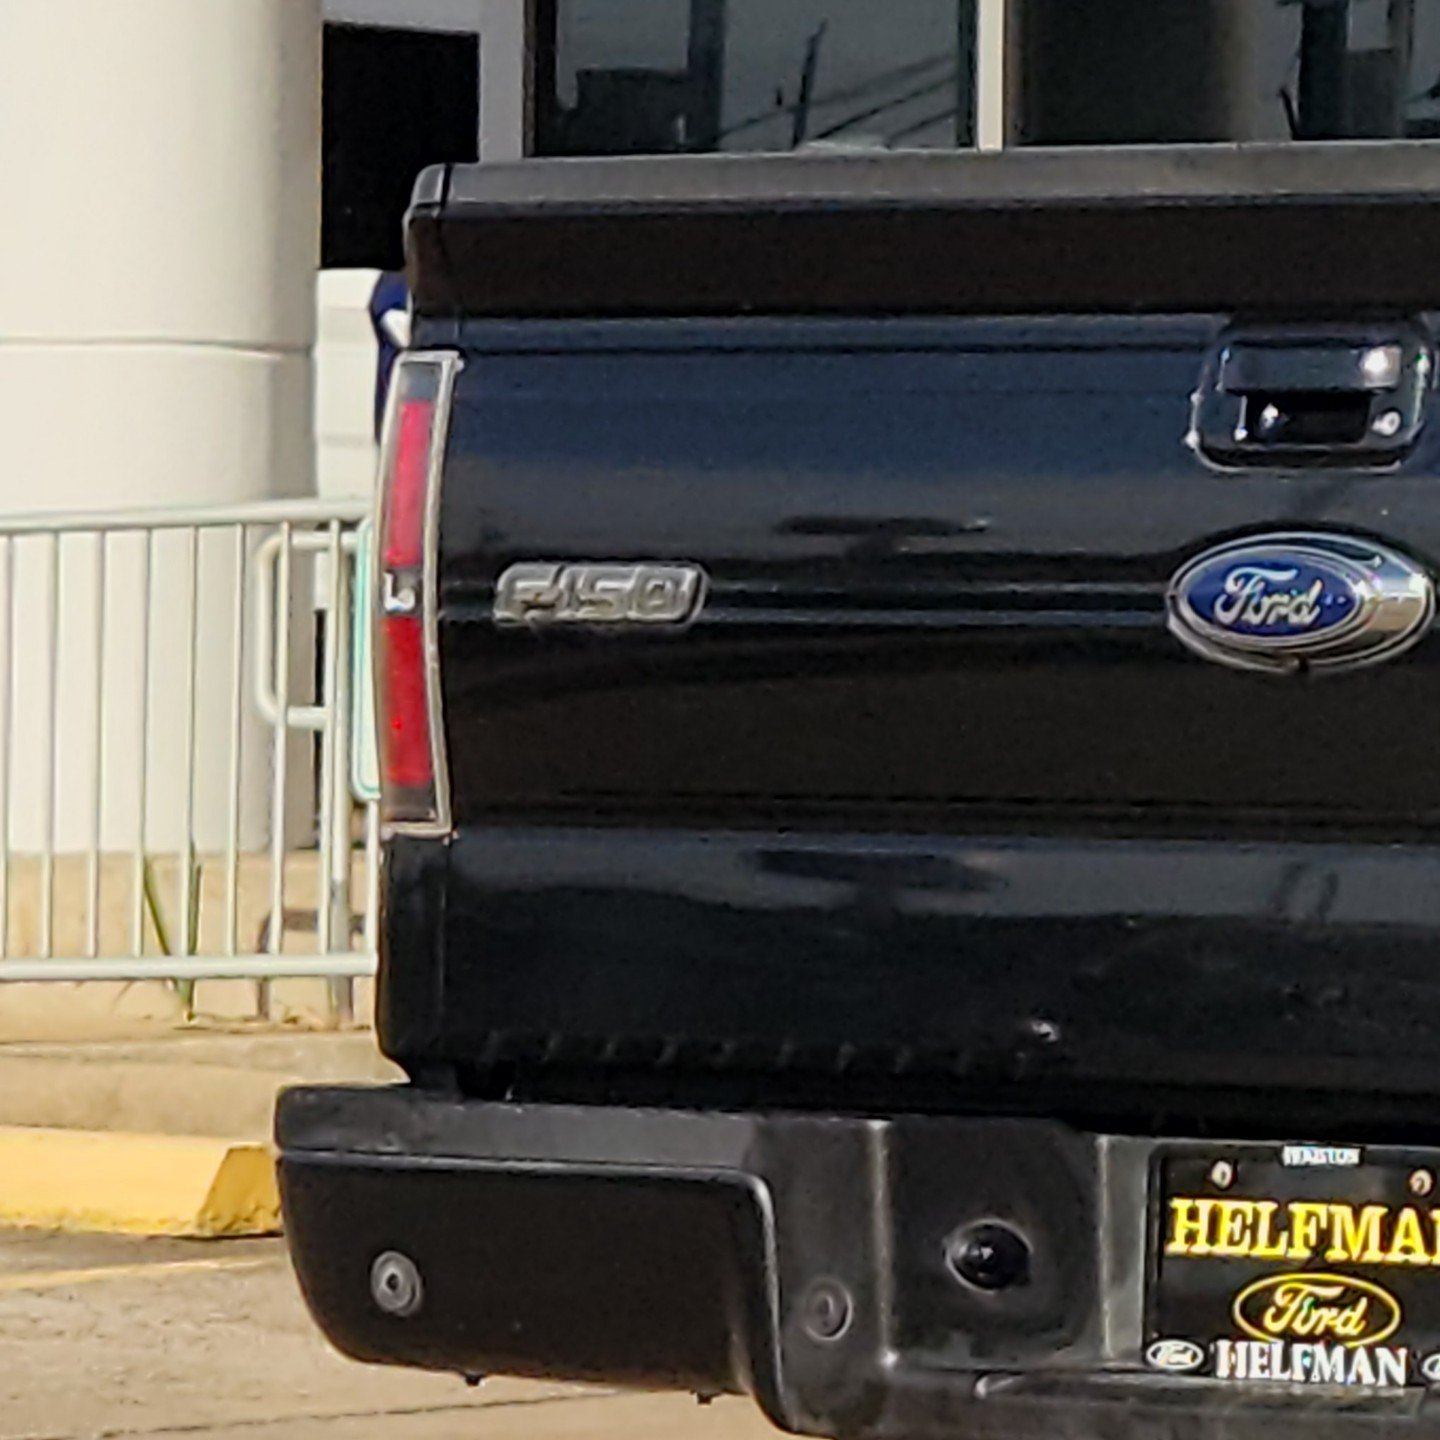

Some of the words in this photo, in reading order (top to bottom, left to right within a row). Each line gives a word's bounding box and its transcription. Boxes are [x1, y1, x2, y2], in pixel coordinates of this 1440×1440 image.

[1213, 566, 1323, 627] Ford
[1263, 1281, 1369, 1337] Ford
[1214, 1339, 1408, 1387] HELFMAN
